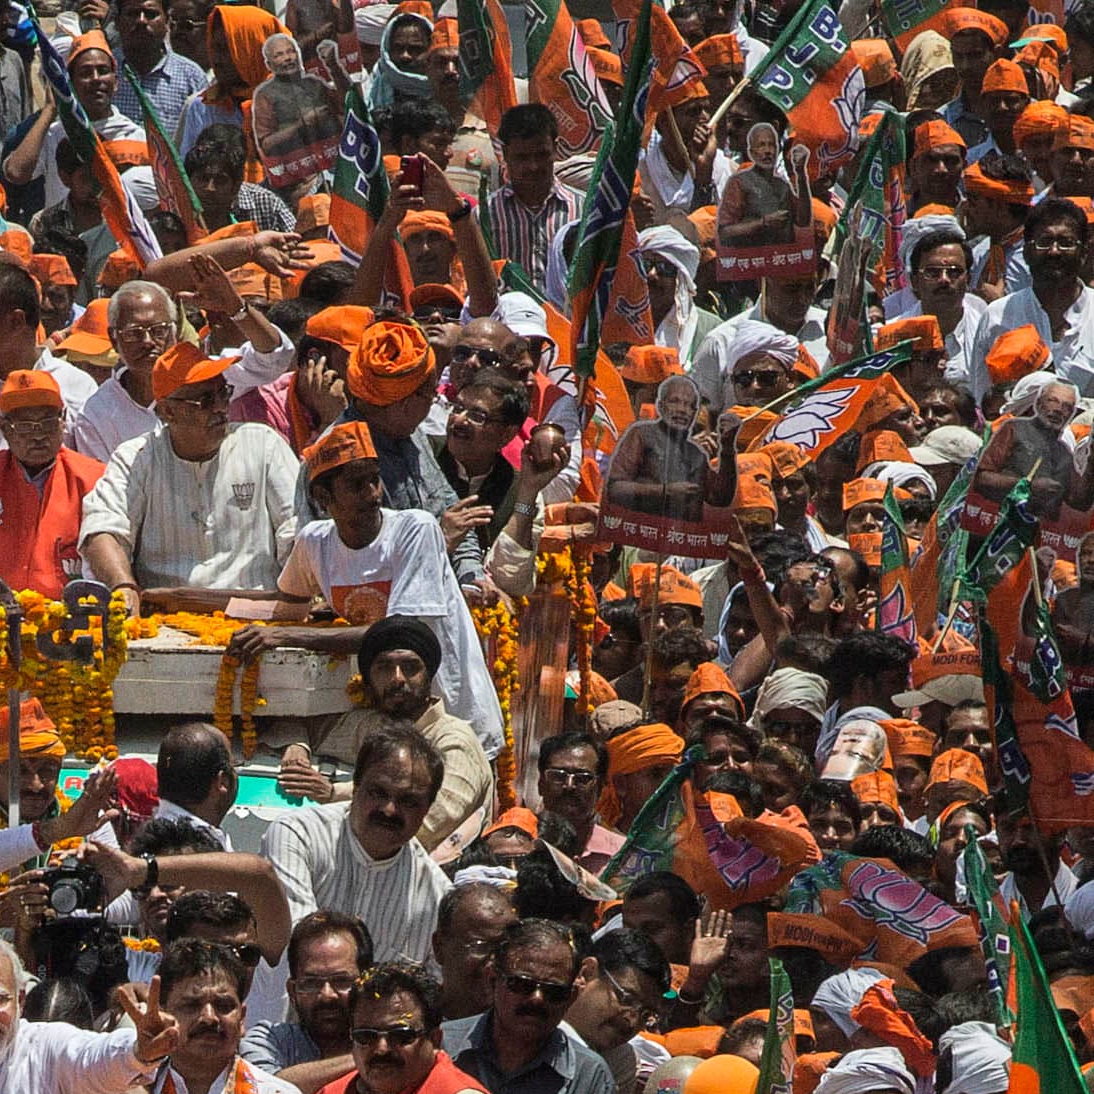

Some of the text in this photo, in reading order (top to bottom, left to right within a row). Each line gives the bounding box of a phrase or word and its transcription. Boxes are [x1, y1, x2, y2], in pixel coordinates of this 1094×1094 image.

[623, 520, 637, 536] एक
[640, 523, 659, 540] भारत
[687, 532, 709, 547] भारत
